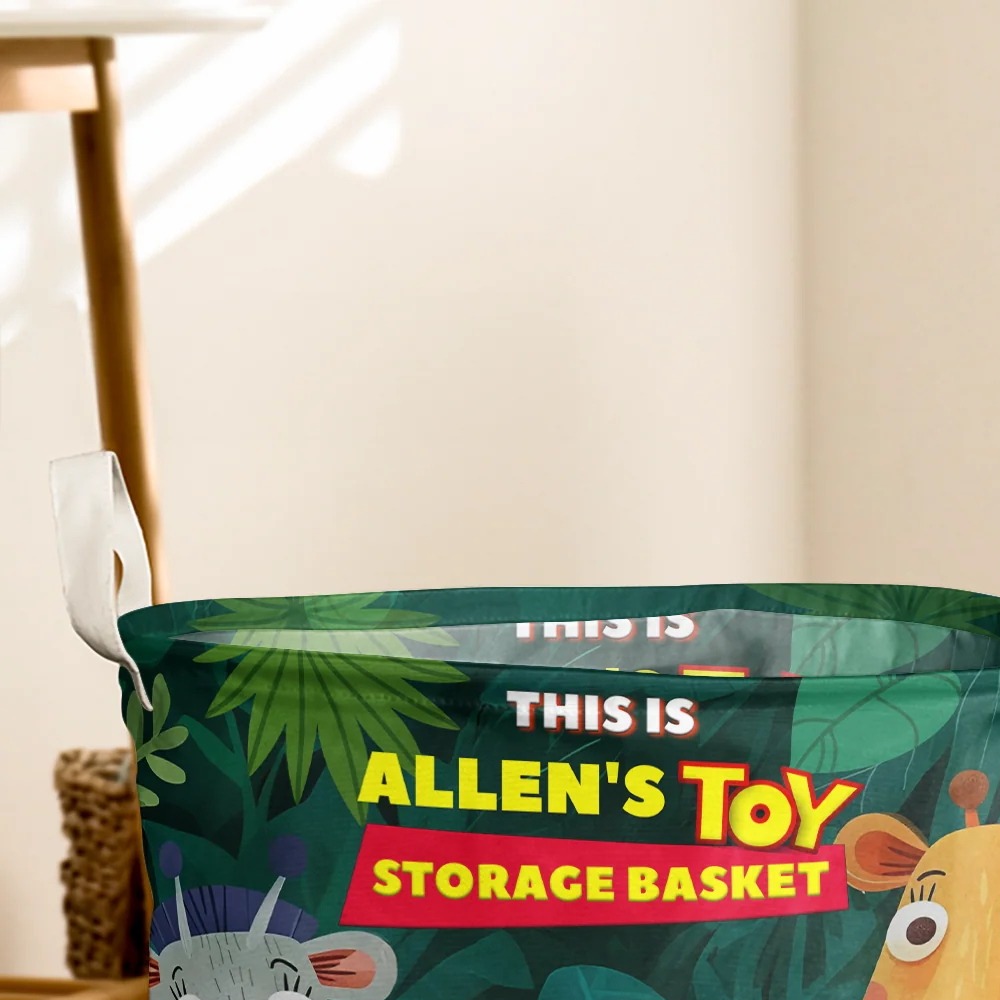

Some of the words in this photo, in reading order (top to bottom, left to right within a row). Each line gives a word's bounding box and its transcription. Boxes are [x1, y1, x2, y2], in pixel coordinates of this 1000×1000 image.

[507, 690, 634, 734] THIS
[646, 697, 697, 736] IS
[357, 751, 666, 818] ALLEN'S
[373, 859, 616, 902] STORAGE
[627, 861, 831, 902] BASKET
